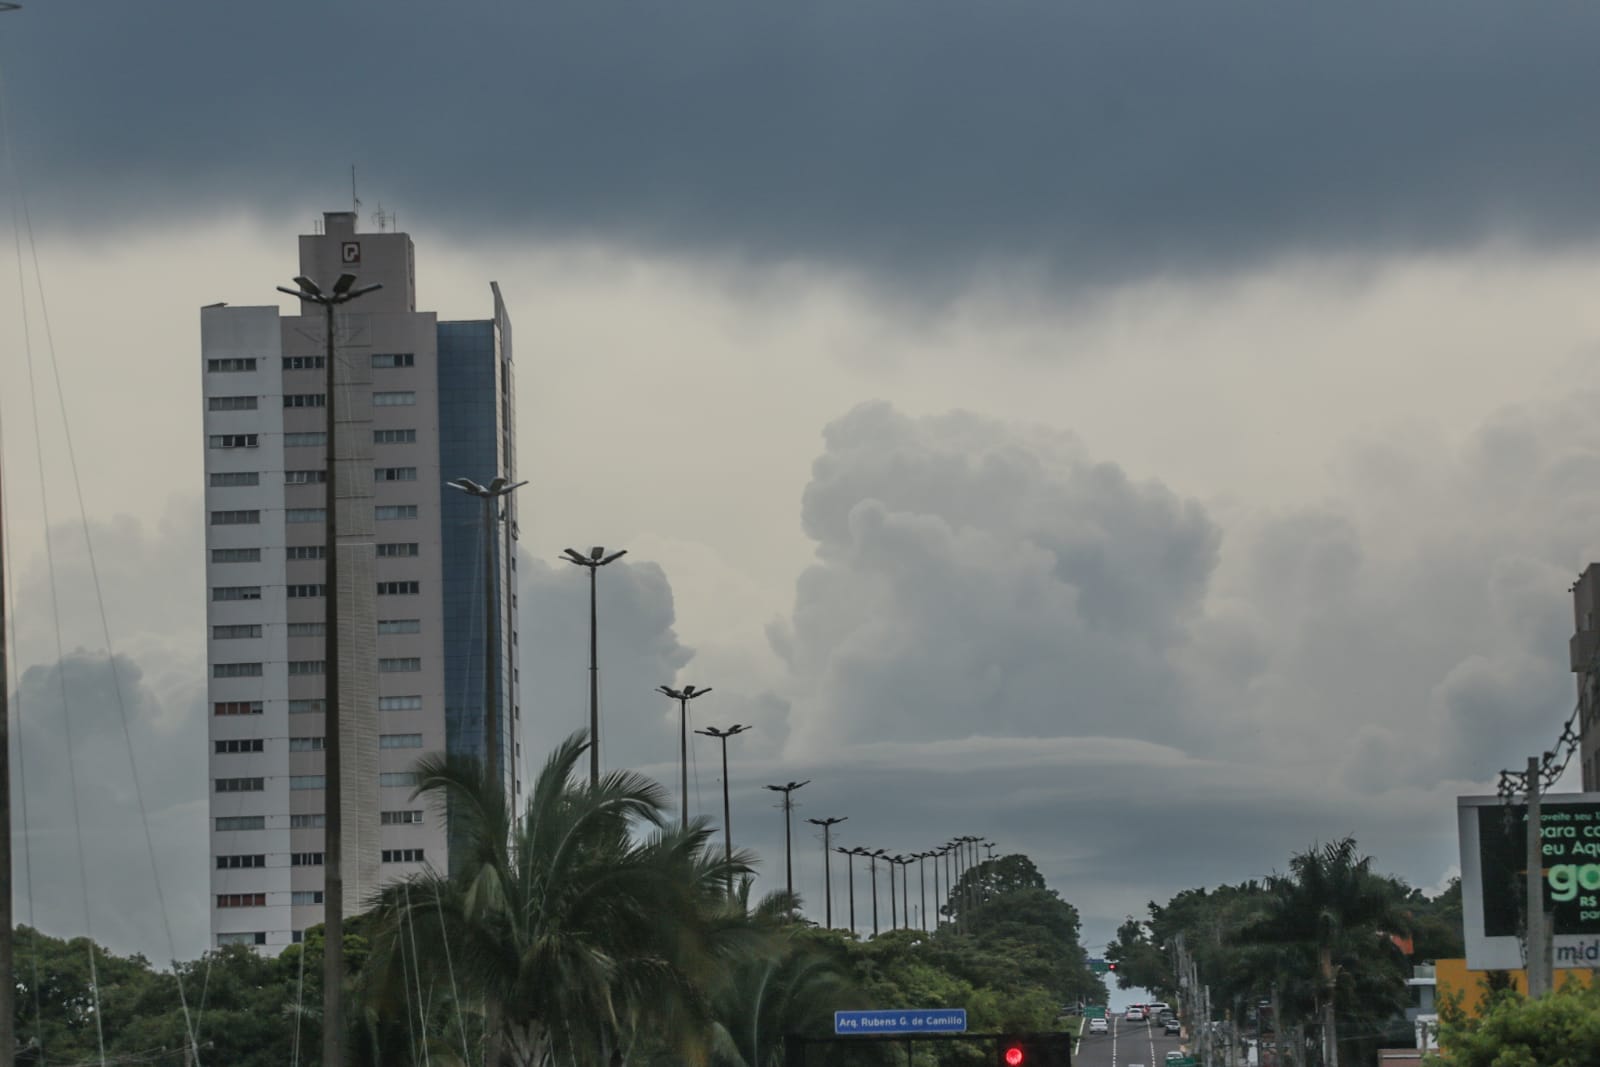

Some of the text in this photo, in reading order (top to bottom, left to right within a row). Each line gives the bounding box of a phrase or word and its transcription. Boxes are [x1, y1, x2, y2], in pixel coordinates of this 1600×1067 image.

[862, 1017, 896, 1027] Rubens
[912, 1016, 923, 1026] de
[926, 1016, 962, 1025] Camillo
